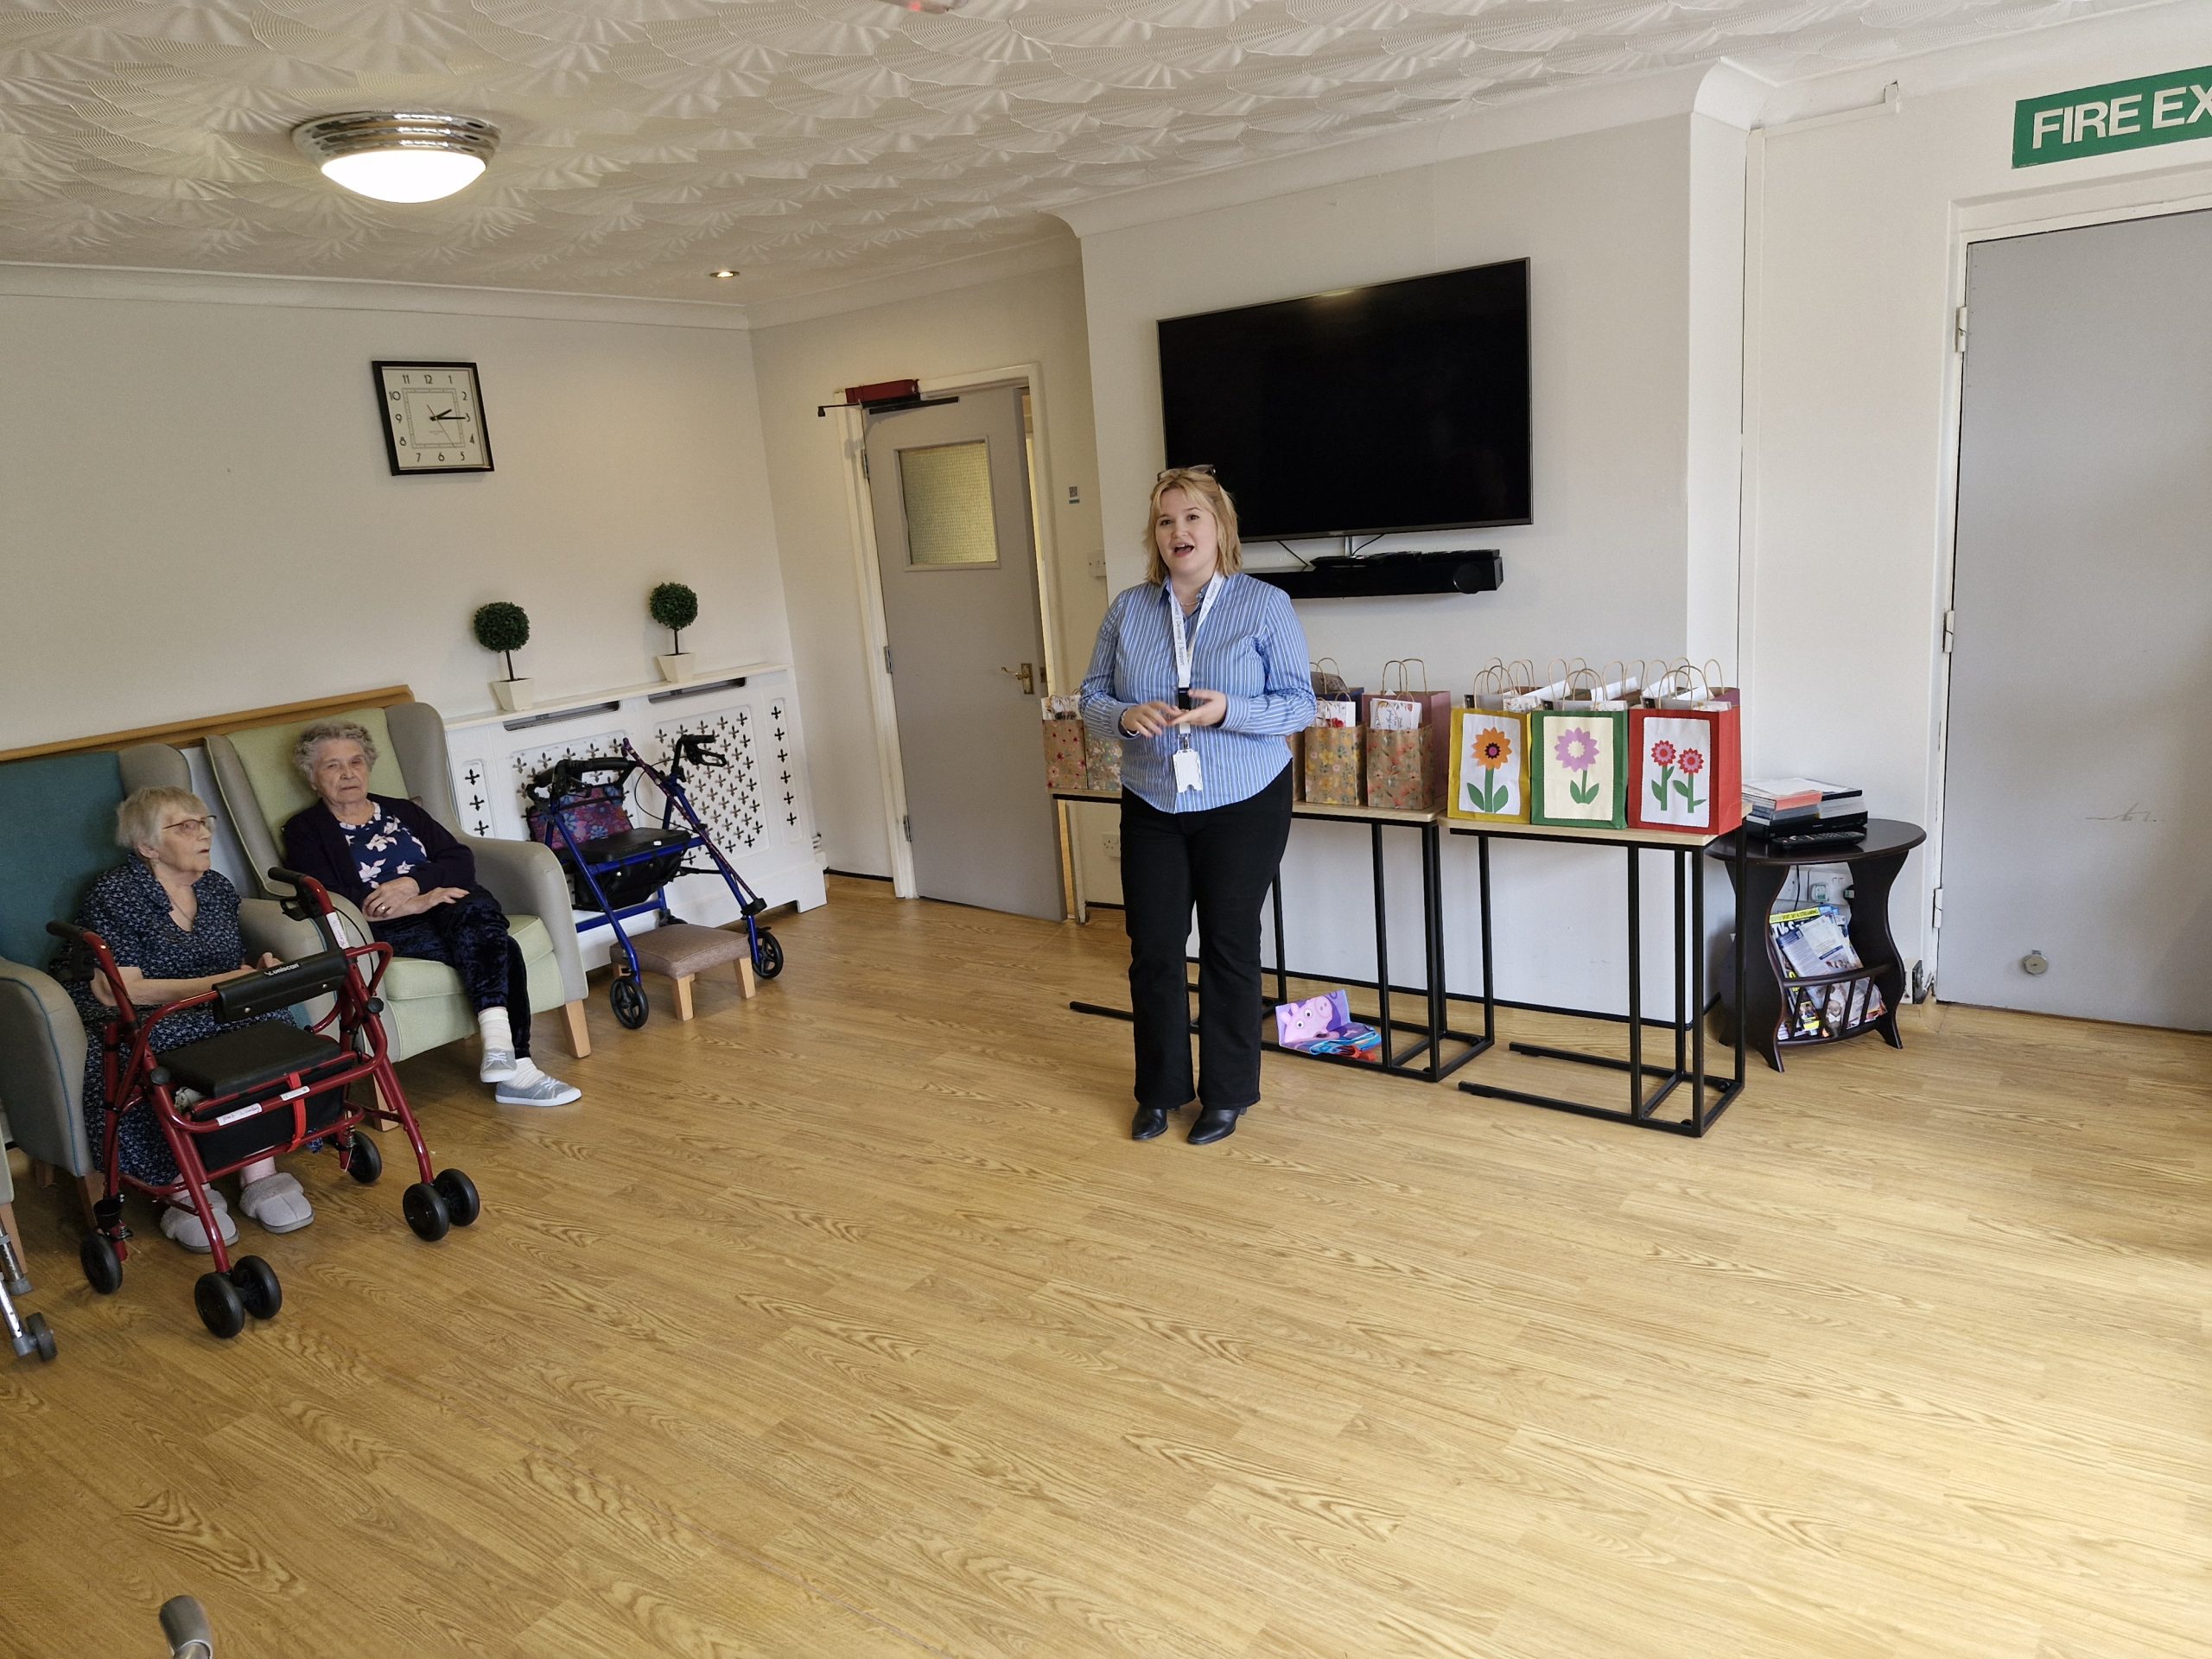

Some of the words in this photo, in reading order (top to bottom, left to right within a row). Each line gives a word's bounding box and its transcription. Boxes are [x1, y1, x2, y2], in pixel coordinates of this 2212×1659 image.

[2032, 93, 2142, 149] FIRE
[402, 374, 410, 384] 11
[424, 374, 433, 384] 12
[448, 375, 453, 384] 1
[389, 391, 401, 401] 10
[461, 391, 467, 400] 2
[395, 413, 402, 423] 9
[465, 413, 471, 423] 3
[399, 436, 407, 446] 8
[469, 434, 475, 444] 4
[416, 453, 422, 462] 7
[438, 452, 445, 461] 6
[460, 452, 465, 461] 5
